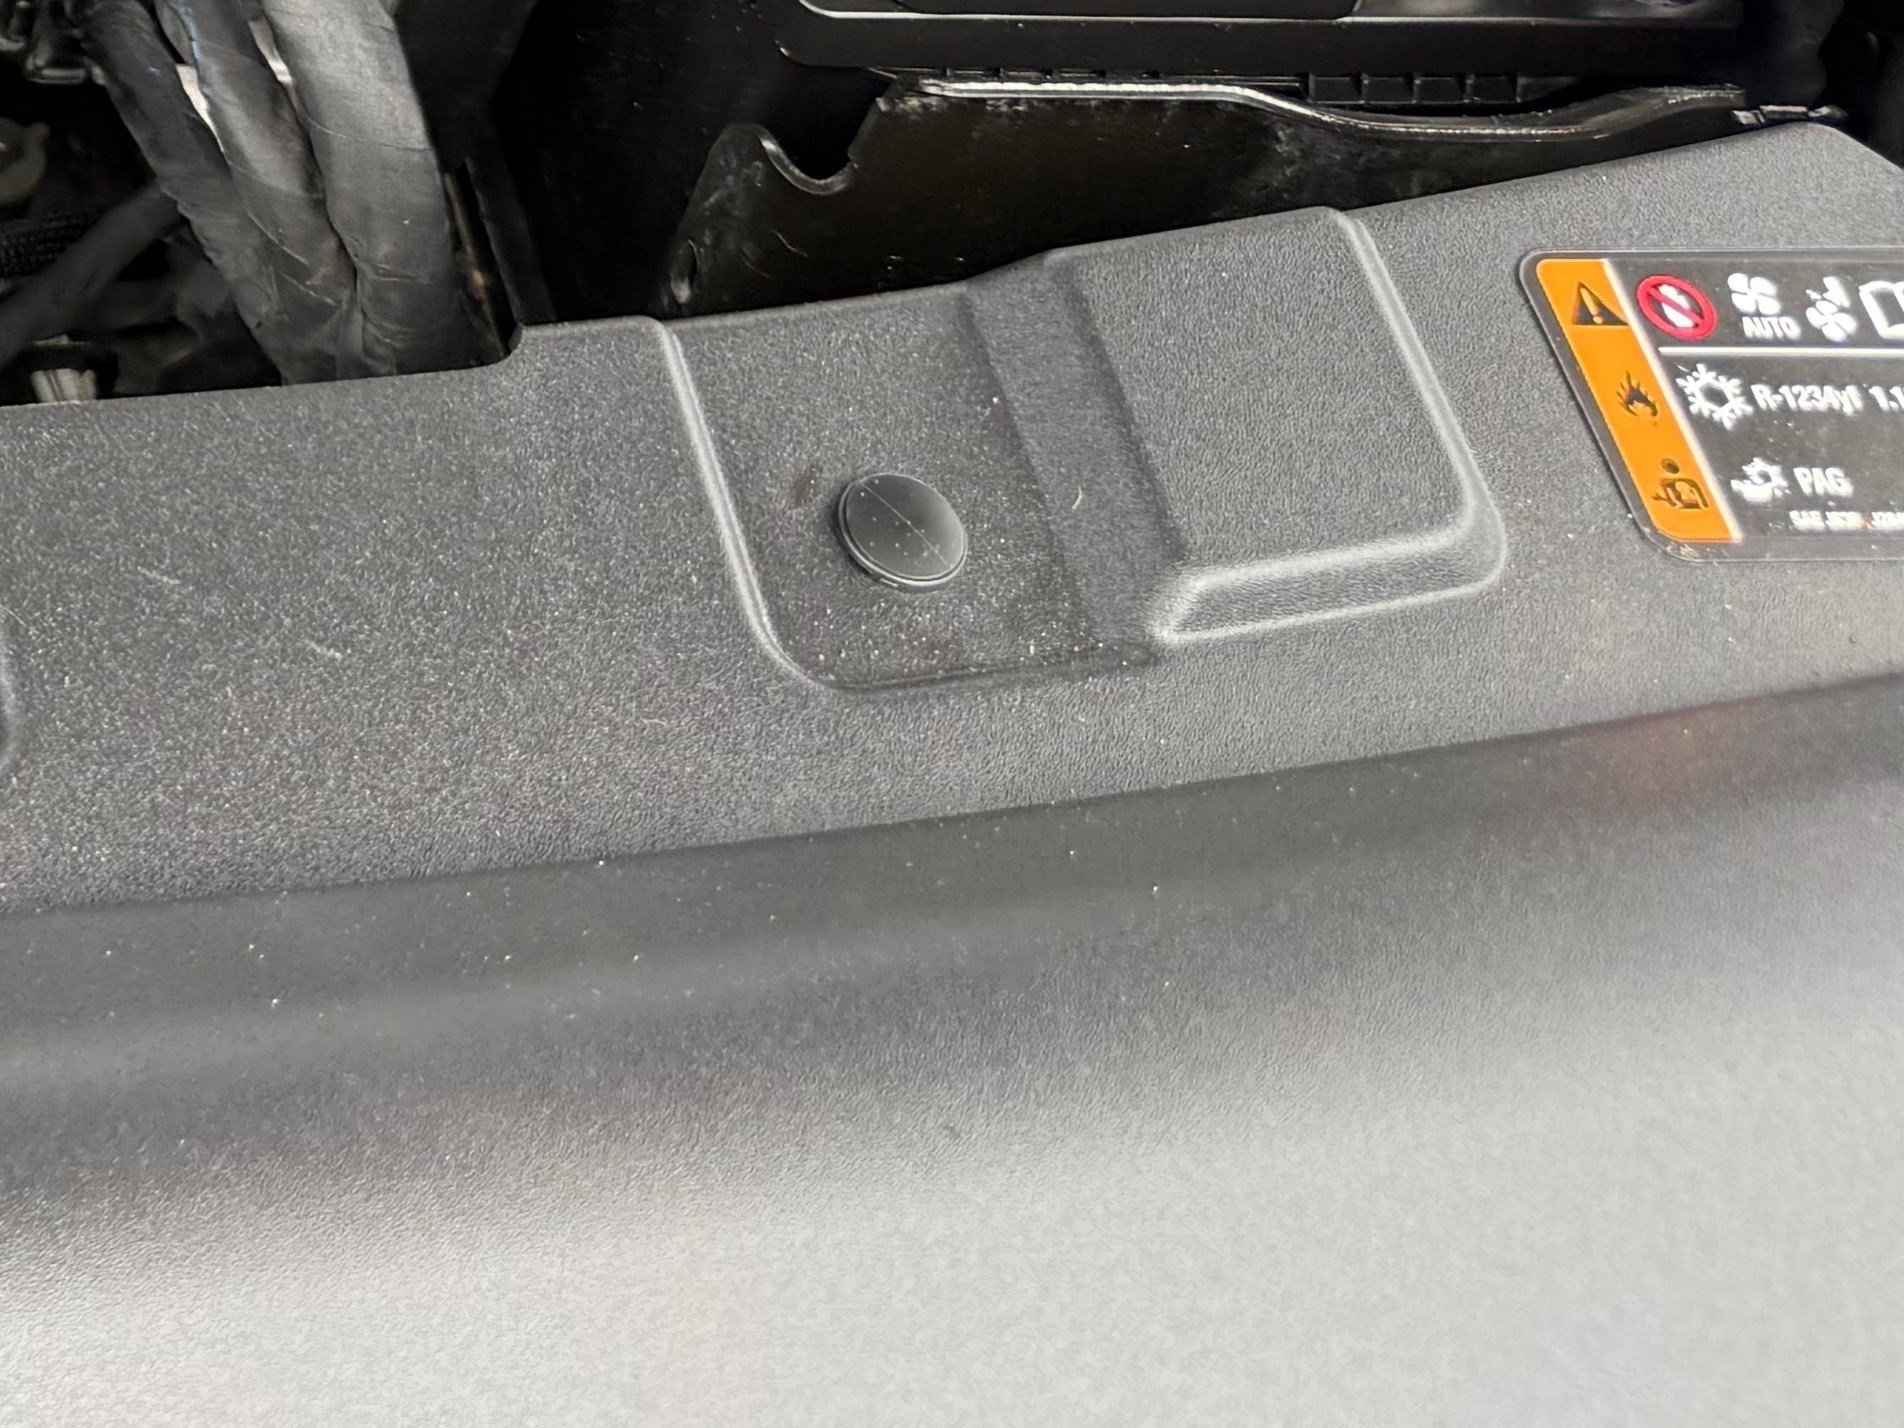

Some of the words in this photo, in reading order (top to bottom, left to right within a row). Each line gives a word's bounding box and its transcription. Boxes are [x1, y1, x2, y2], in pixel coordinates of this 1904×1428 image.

[1741, 315, 1801, 340] AUTO
[1750, 383, 1865, 418] R-1234yf
[1793, 466, 1855, 498] PAG
